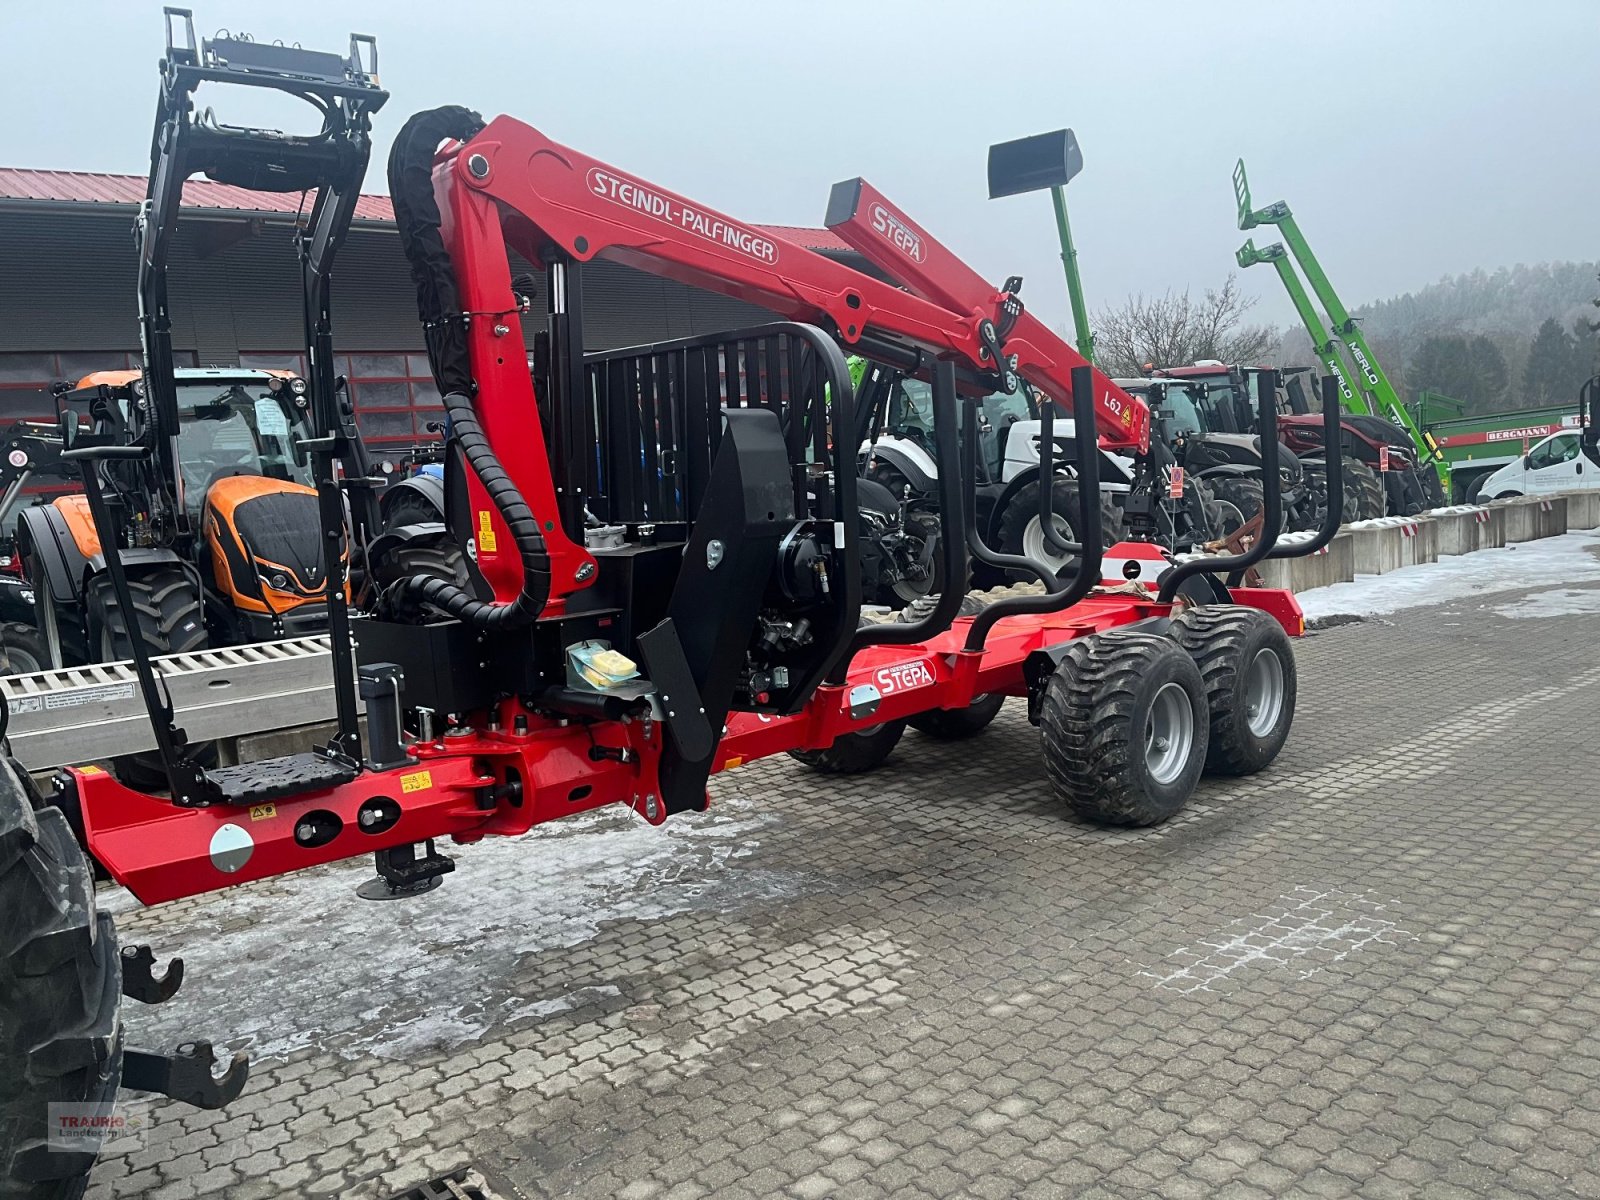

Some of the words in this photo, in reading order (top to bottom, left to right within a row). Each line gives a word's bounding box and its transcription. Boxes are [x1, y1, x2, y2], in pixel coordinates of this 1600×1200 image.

[594, 172, 774, 261] STEINDL-PALFINGER
[873, 206, 920, 262] STEPA
[1327, 359, 1353, 399] MERLO
[1348, 341, 1379, 385] MERLO
[1104, 390, 1121, 416] L62
[1488, 427, 1548, 440] BERGMANN
[877, 665, 933, 694] STEPA
